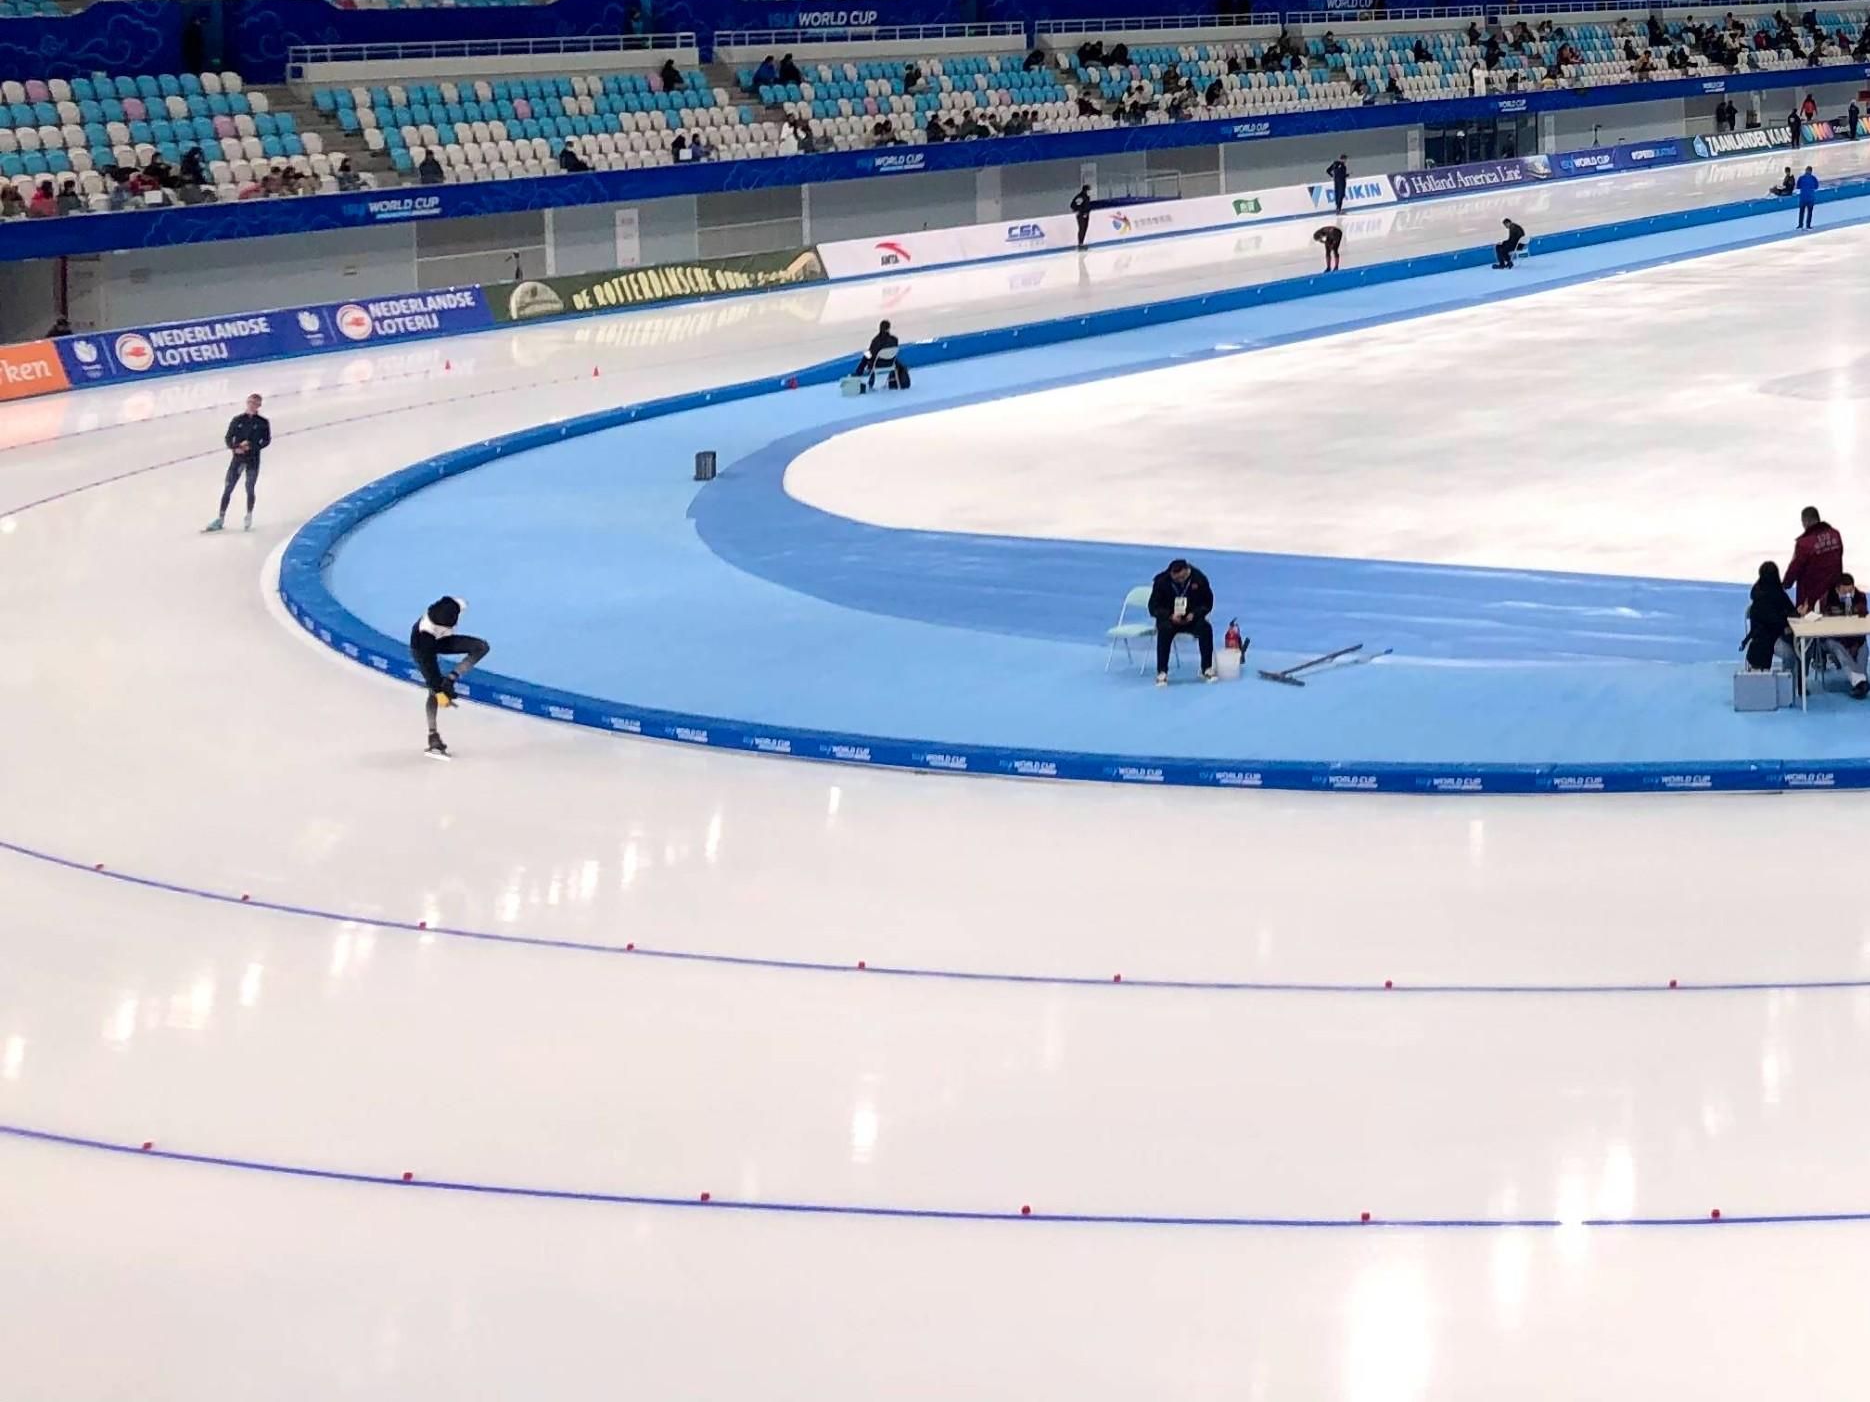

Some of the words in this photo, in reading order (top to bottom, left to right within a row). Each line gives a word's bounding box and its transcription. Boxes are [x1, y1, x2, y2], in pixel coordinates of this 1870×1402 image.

[799, 12, 847, 26] WORLD
[850, 11, 877, 25] CUP
[875, 156, 904, 167] WORLD
[906, 153, 924, 164] CUP
[1412, 171, 1455, 194] Holland
[1455, 166, 1500, 189] America
[1499, 164, 1522, 183] Line
[369, 199, 413, 212] WORLD
[415, 196, 440, 209] CUP
[1326, 182, 1383, 203] DIKIN
[369, 291, 476, 319] NEDERLANDSE
[573, 289, 593, 311] DE
[149, 316, 271, 348] NEDERLANDSE
[375, 312, 440, 336] LOTERIJ
[157, 342, 229, 366] LOTERIJ
